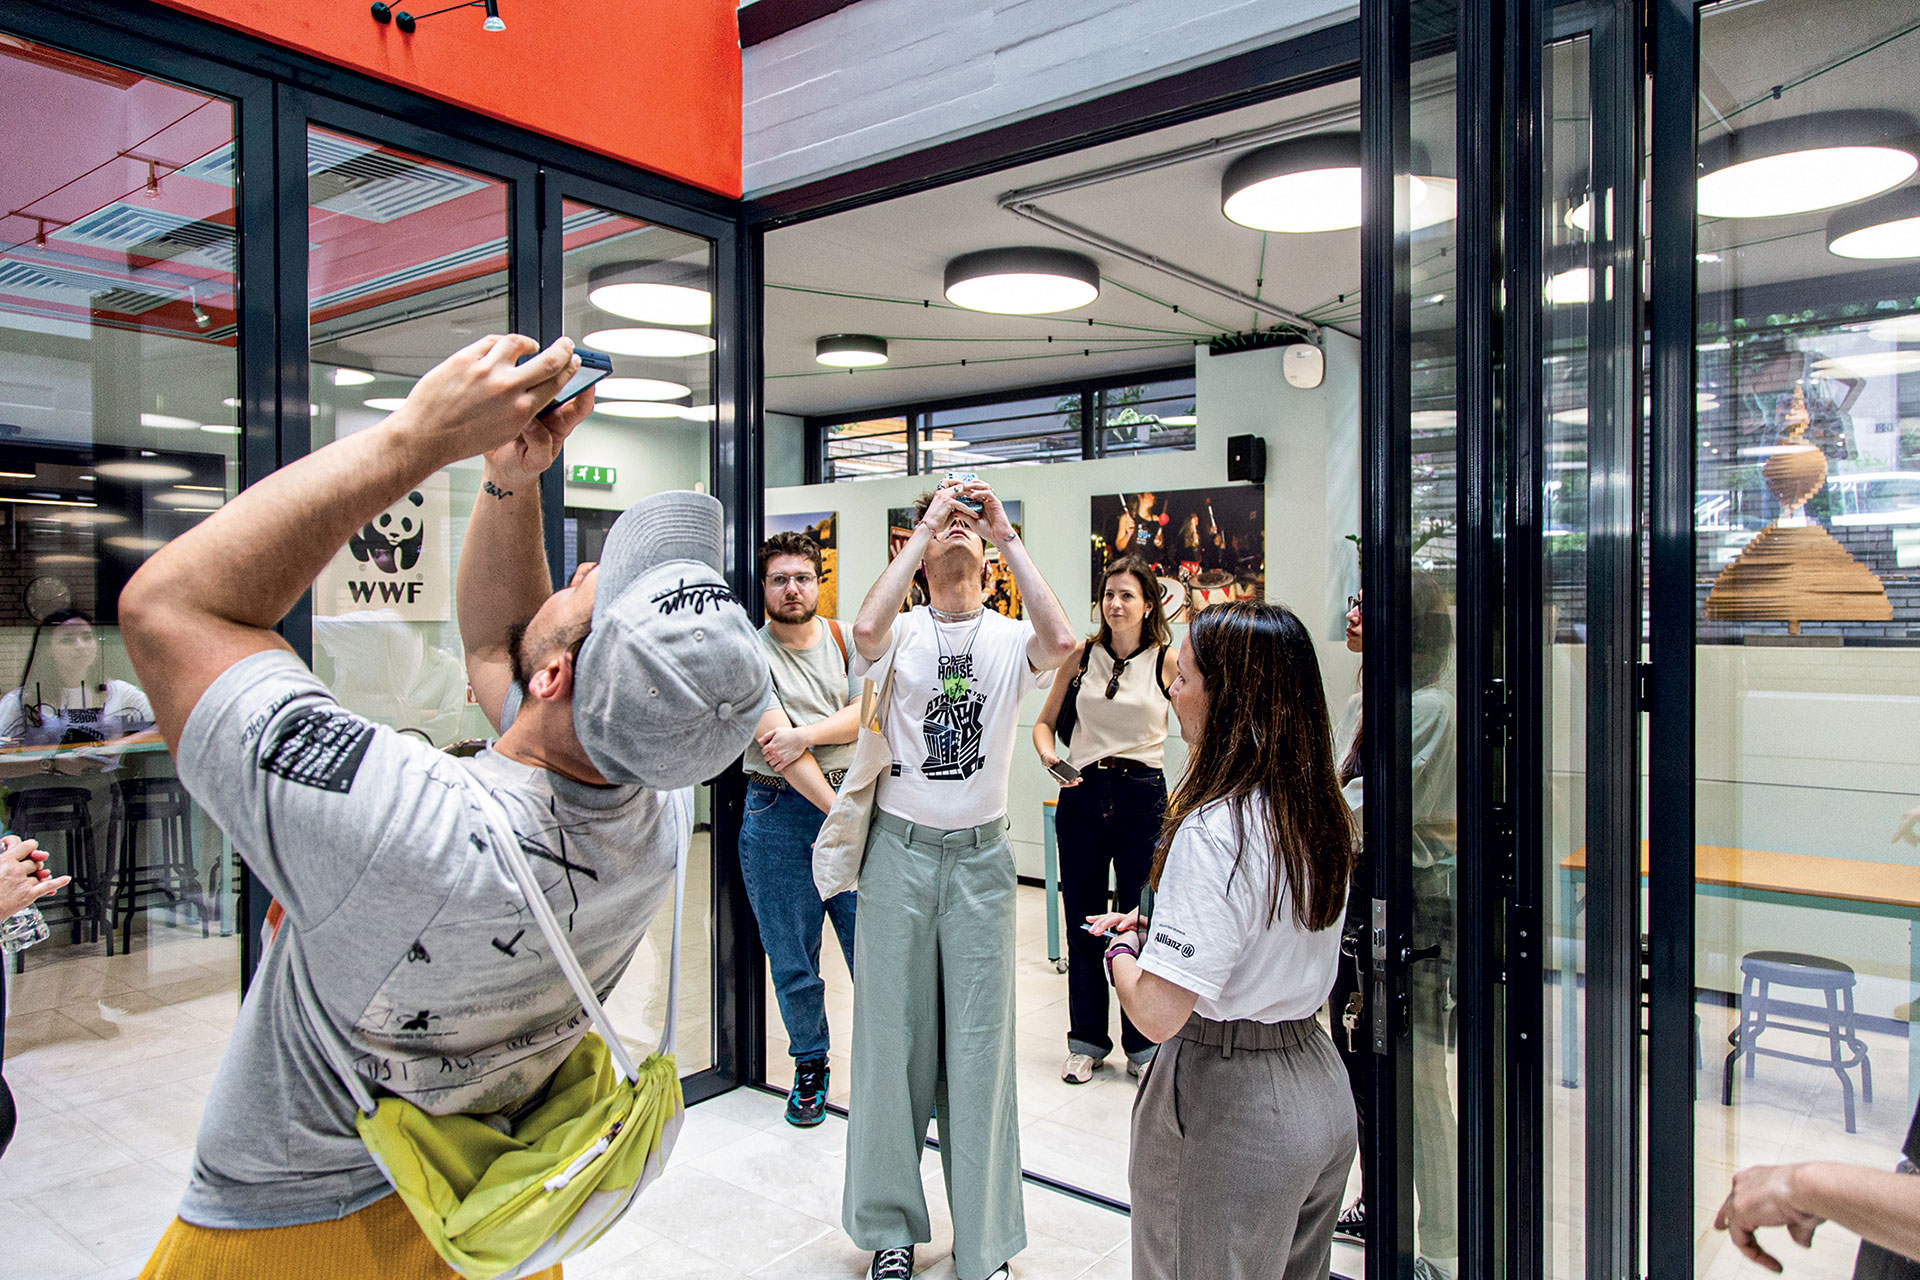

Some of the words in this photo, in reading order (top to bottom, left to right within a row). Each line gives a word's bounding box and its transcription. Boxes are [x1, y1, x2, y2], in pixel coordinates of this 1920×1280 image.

[348, 581, 423, 603] WWF
[938, 654, 973, 665] OPEN
[938, 664, 974, 680] HOUSE
[1154, 932, 1182, 951] Allianz
